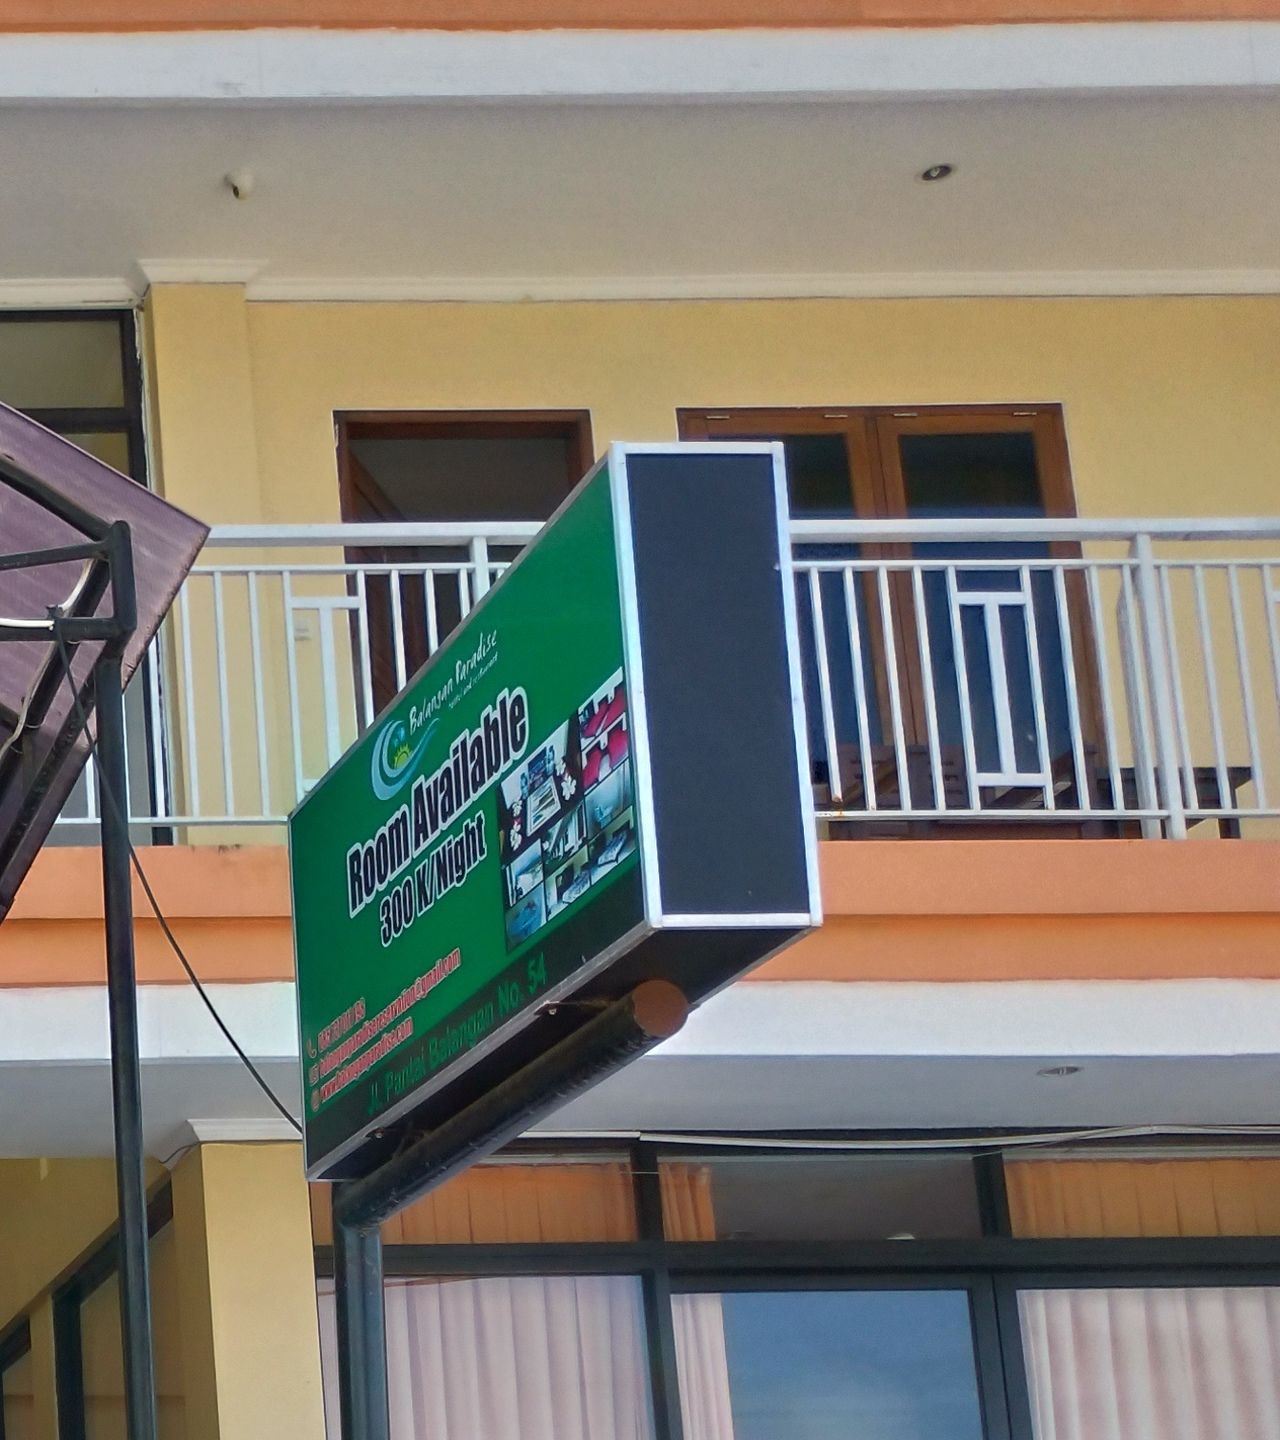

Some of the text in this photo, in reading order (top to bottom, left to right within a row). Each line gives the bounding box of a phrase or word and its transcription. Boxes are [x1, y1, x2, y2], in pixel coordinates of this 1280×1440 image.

[347, 686, 530, 919] Room Available
[380, 810, 488, 947] 300 K/Night
[385, 1049, 426, 1102] Pantai
[429, 1002, 495, 1068] Balangan
